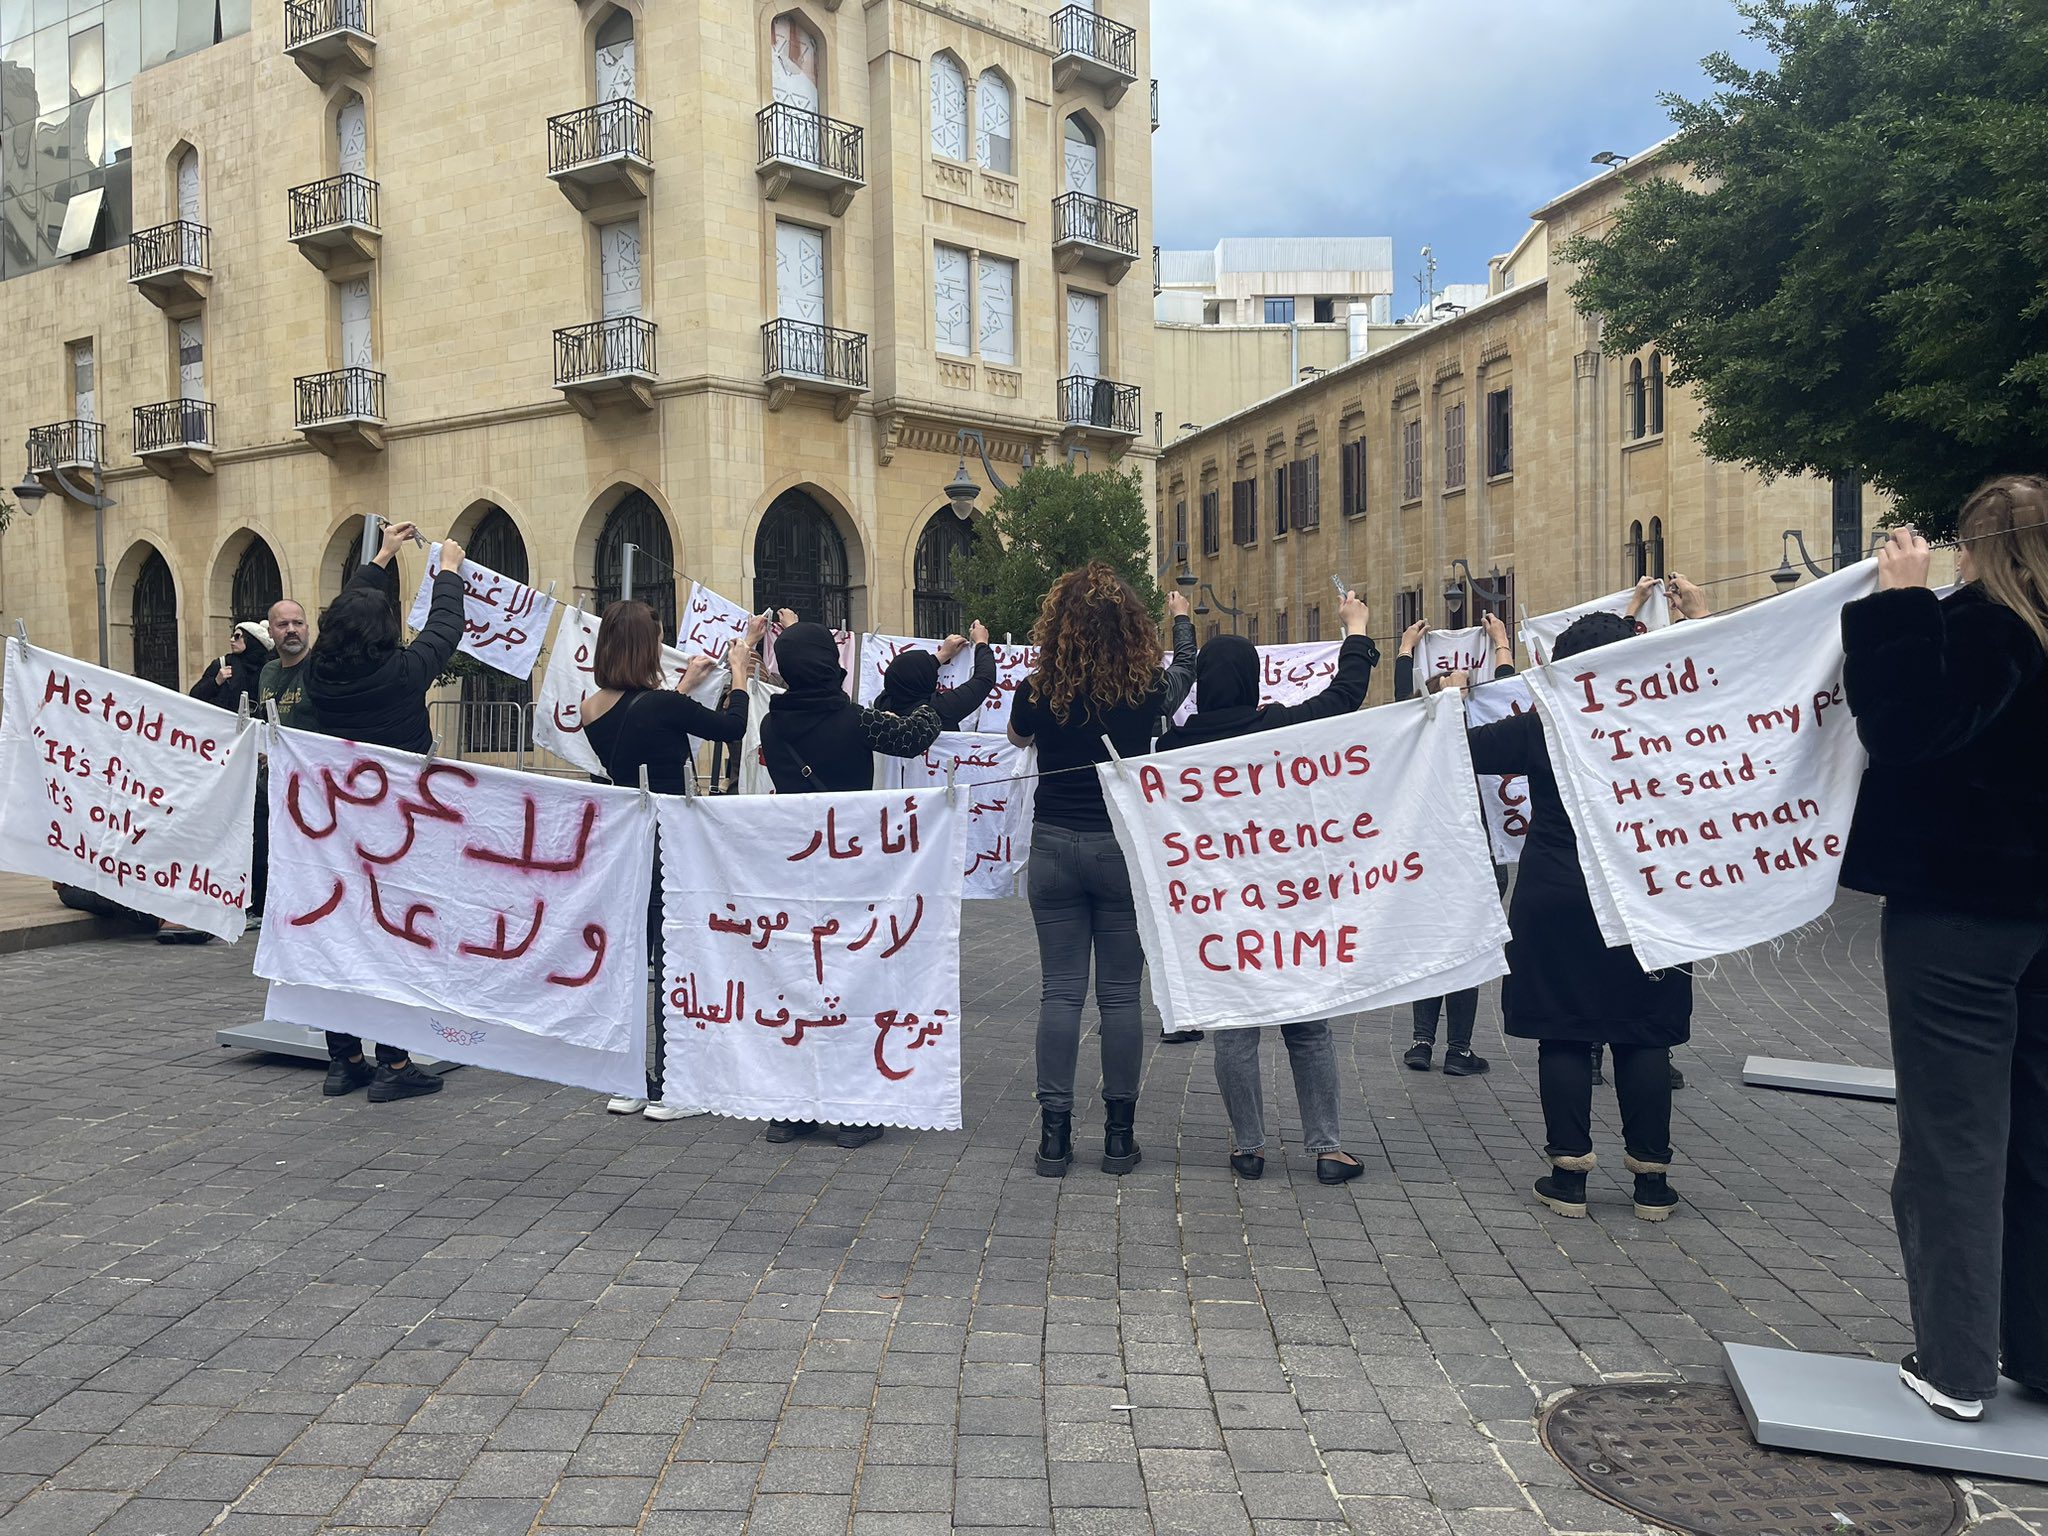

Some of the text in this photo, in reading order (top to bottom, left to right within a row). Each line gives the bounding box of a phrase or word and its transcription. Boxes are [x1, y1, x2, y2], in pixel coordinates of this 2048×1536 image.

[692, 598, 729, 624] عرض
[1574, 657, 1719, 714] I said:
[1685, 721, 1727, 748] on
[1747, 703, 1800, 733] my
[1814, 681, 1845, 727] pe
[45, 670, 231, 767] He told me:
[103, 757, 174, 815] fine,
[1139, 744, 1371, 804] A serious
[1612, 753, 1777, 805] He said:
[45, 778, 147, 845] it's only
[463, 795, 597, 873] لا
[787, 795, 920, 862] أنا عار
[1700, 819, 1722, 841] a
[1732, 798, 1820, 833] man
[47, 821, 70, 850] 2
[74, 834, 147, 887] drops
[154, 862, 181, 888] of
[1168, 851, 1425, 915] for a serious
[1639, 834, 1841, 896] I can take
[291, 863, 436, 950] عار
[812, 893, 925, 985] لازم
[1198, 925, 1359, 973] CRIME
[670, 971, 746, 1031] العيلة
[755, 993, 847, 1047] شرف
